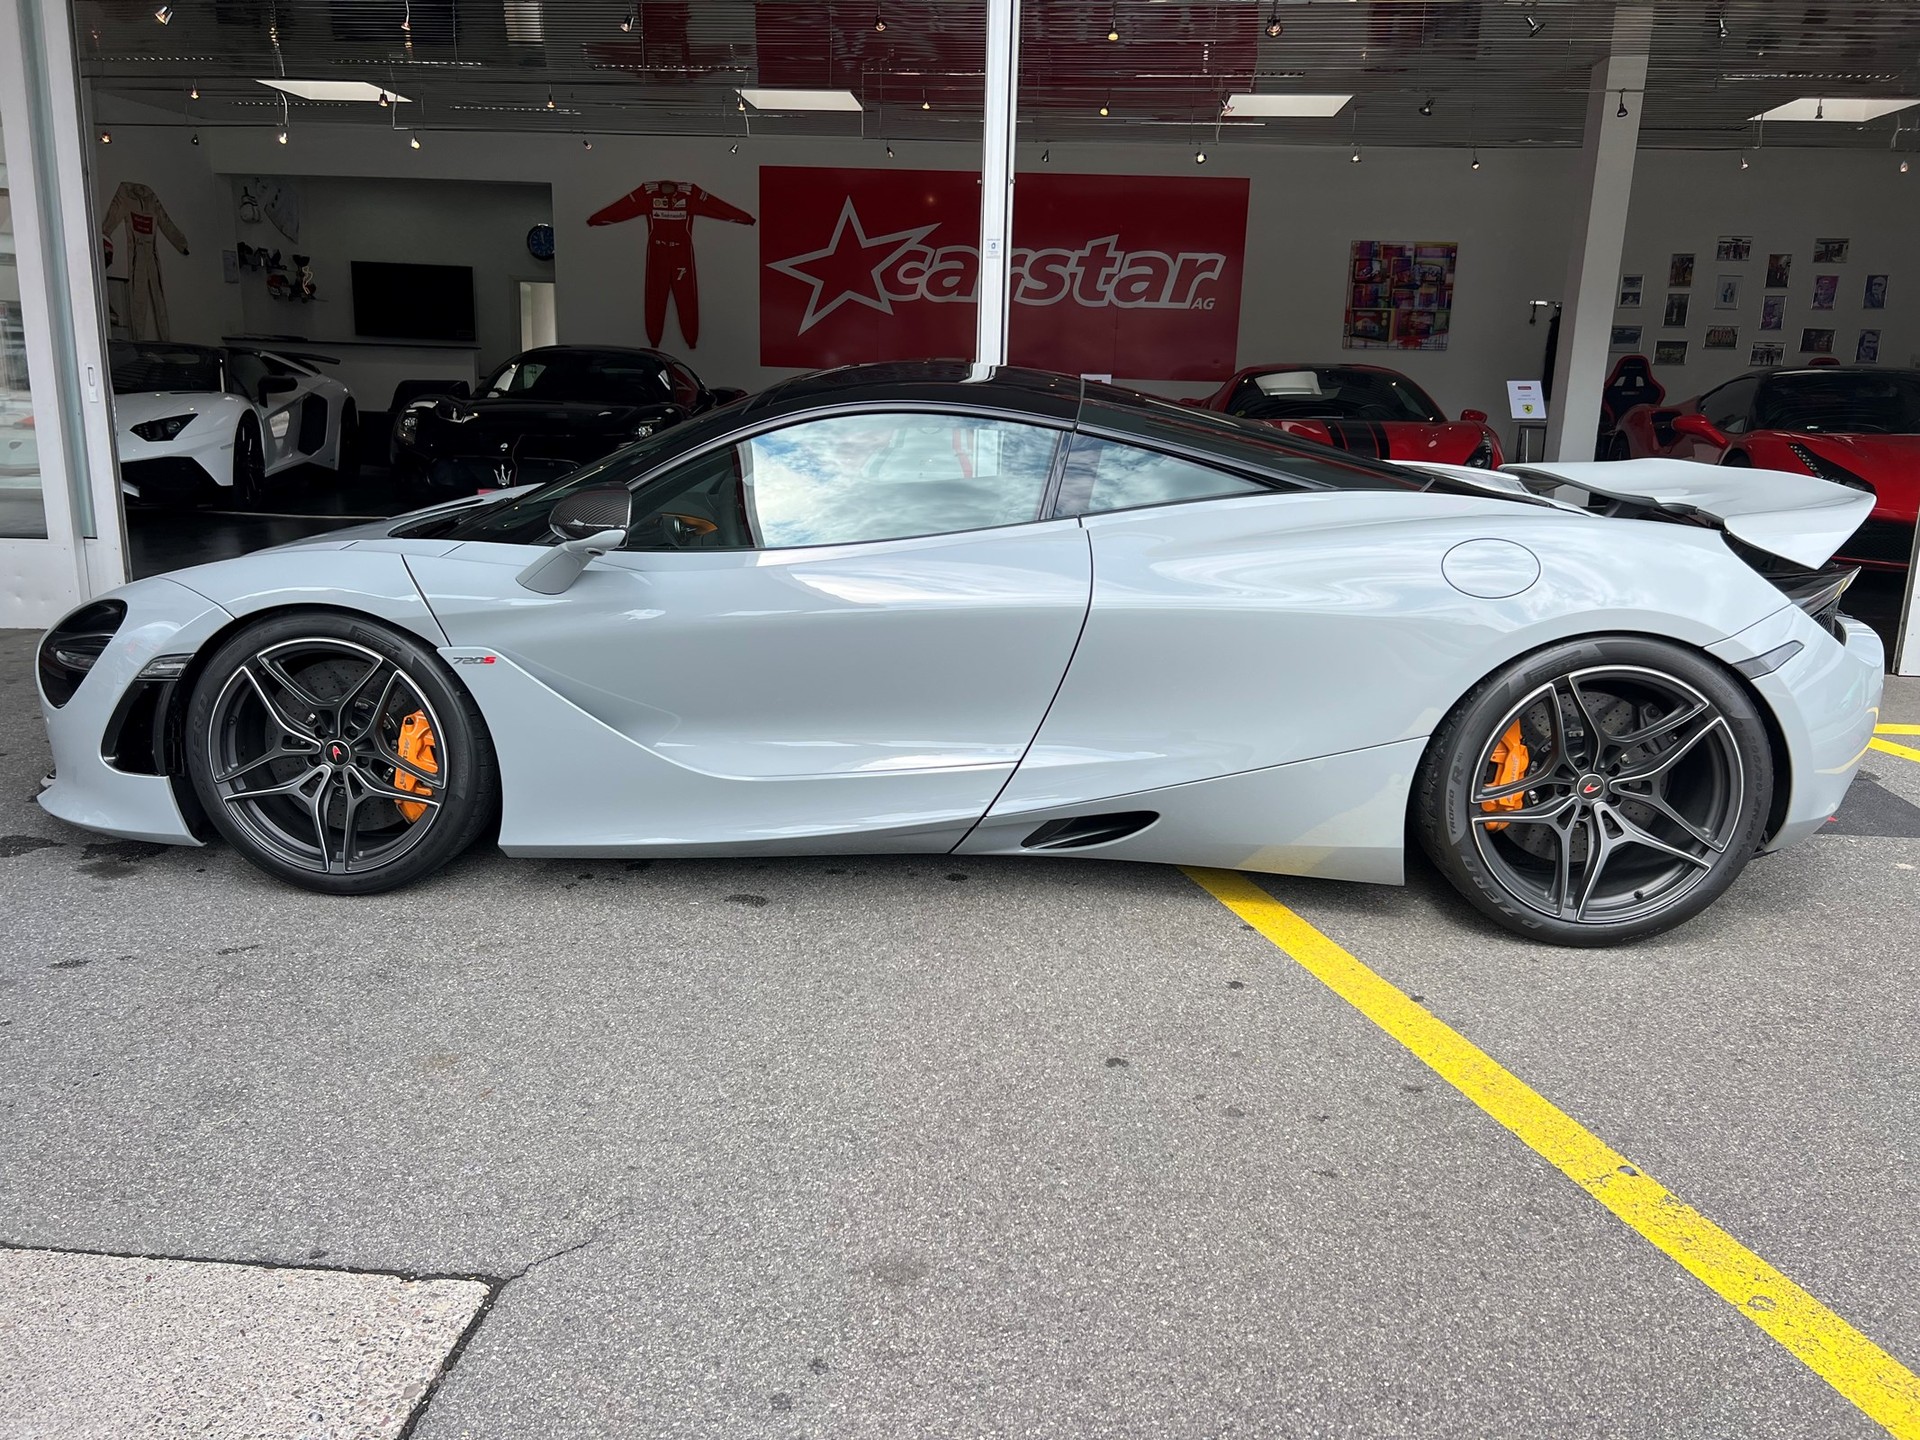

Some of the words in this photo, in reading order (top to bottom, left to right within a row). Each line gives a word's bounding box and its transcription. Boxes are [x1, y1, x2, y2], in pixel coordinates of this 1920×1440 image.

[676, 267, 687, 281] 7
[1191, 297, 1215, 310] AG
[453, 656, 497, 665] 720S
[1451, 765, 1464, 786] R
[1448, 788, 1457, 835] TROFEO
[1460, 855, 1521, 918] ZERO
[1520, 919, 1544, 929] P
